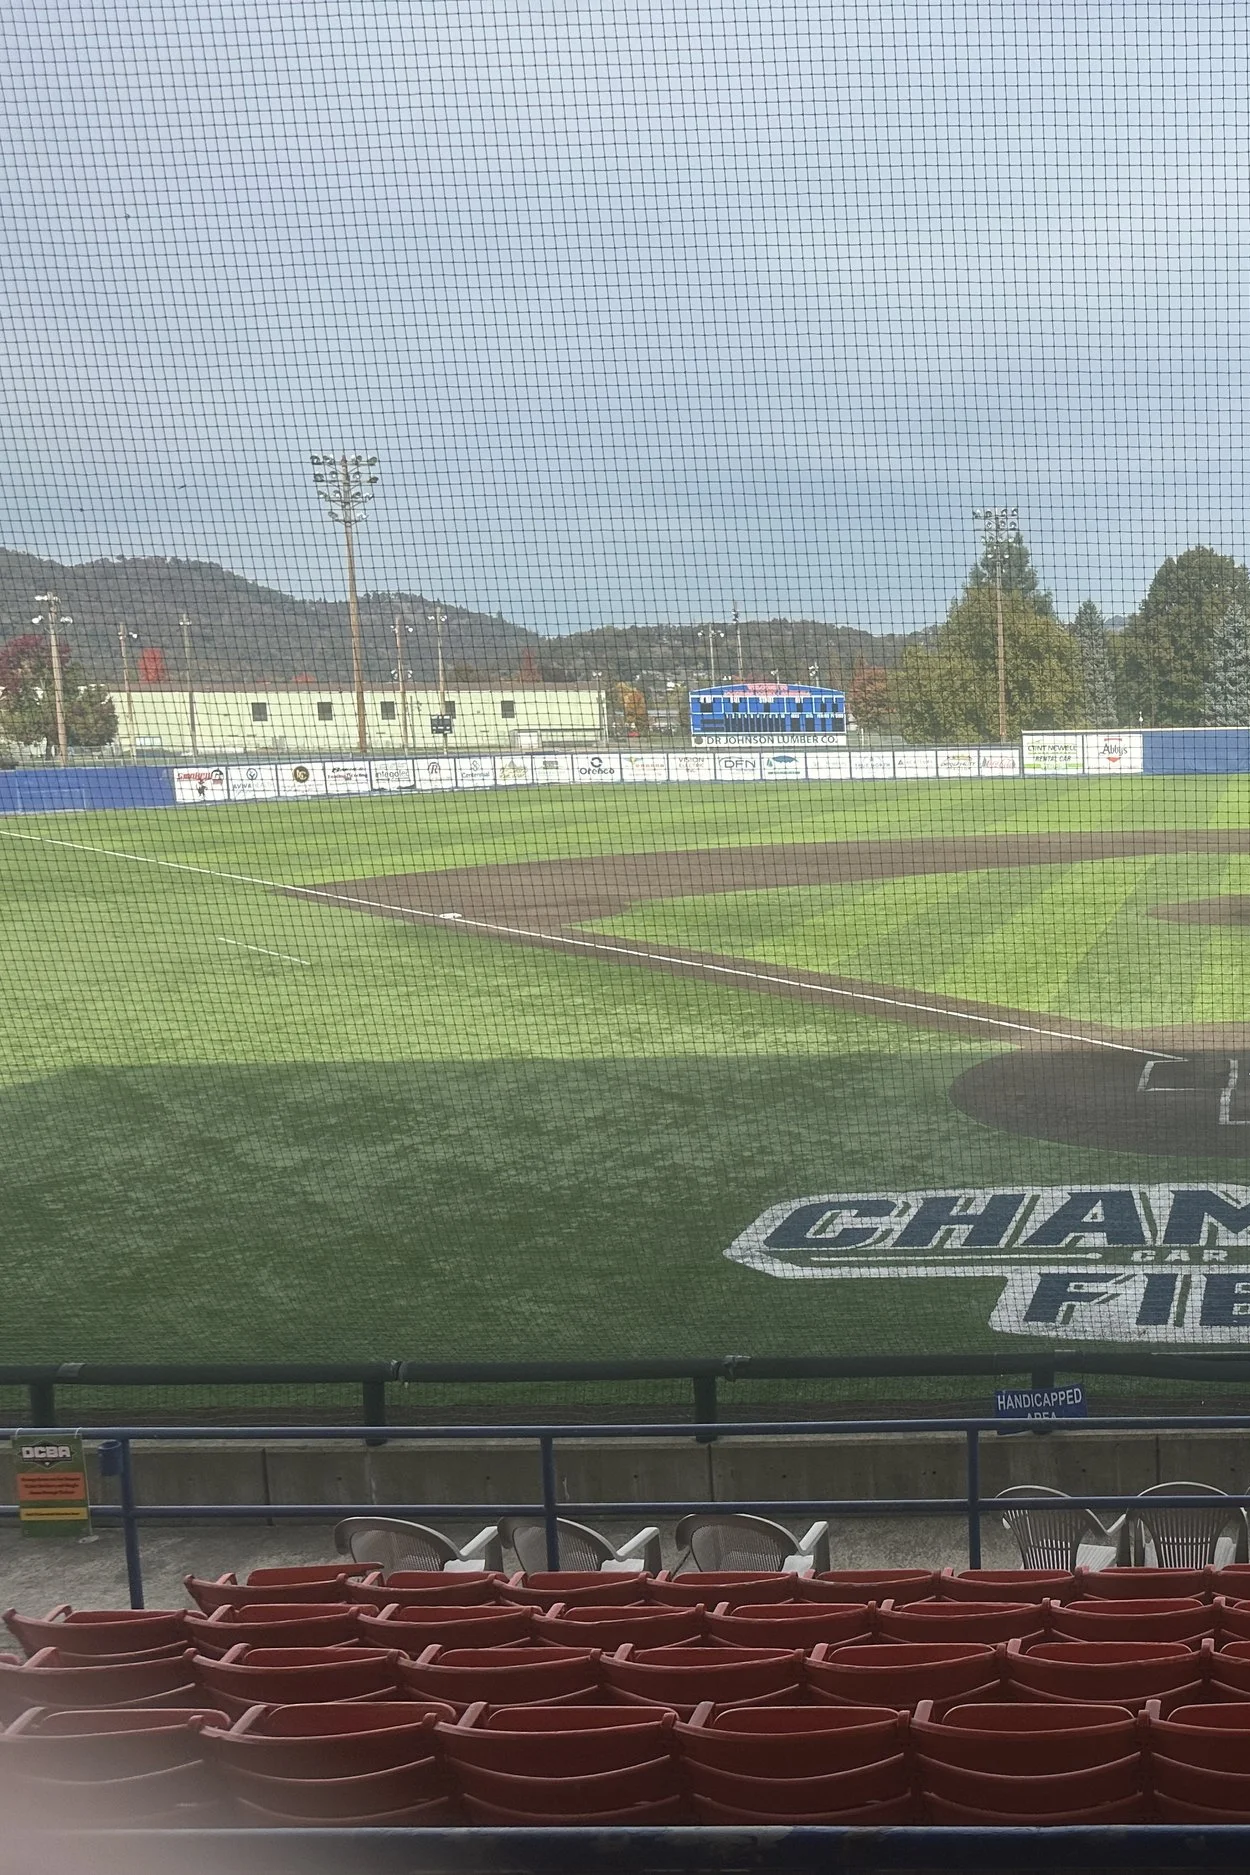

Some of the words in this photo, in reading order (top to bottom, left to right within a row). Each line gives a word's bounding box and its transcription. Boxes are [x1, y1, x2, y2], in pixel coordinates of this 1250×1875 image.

[706, 736, 721, 745] DR
[724, 735, 774, 745] JOHNSON
[777, 735, 818, 744] LUMBER
[821, 735, 839, 744] CO.
[1131, 1249, 1241, 1263] CAR
[997, 1387, 1083, 1411] HANDICAPPED
